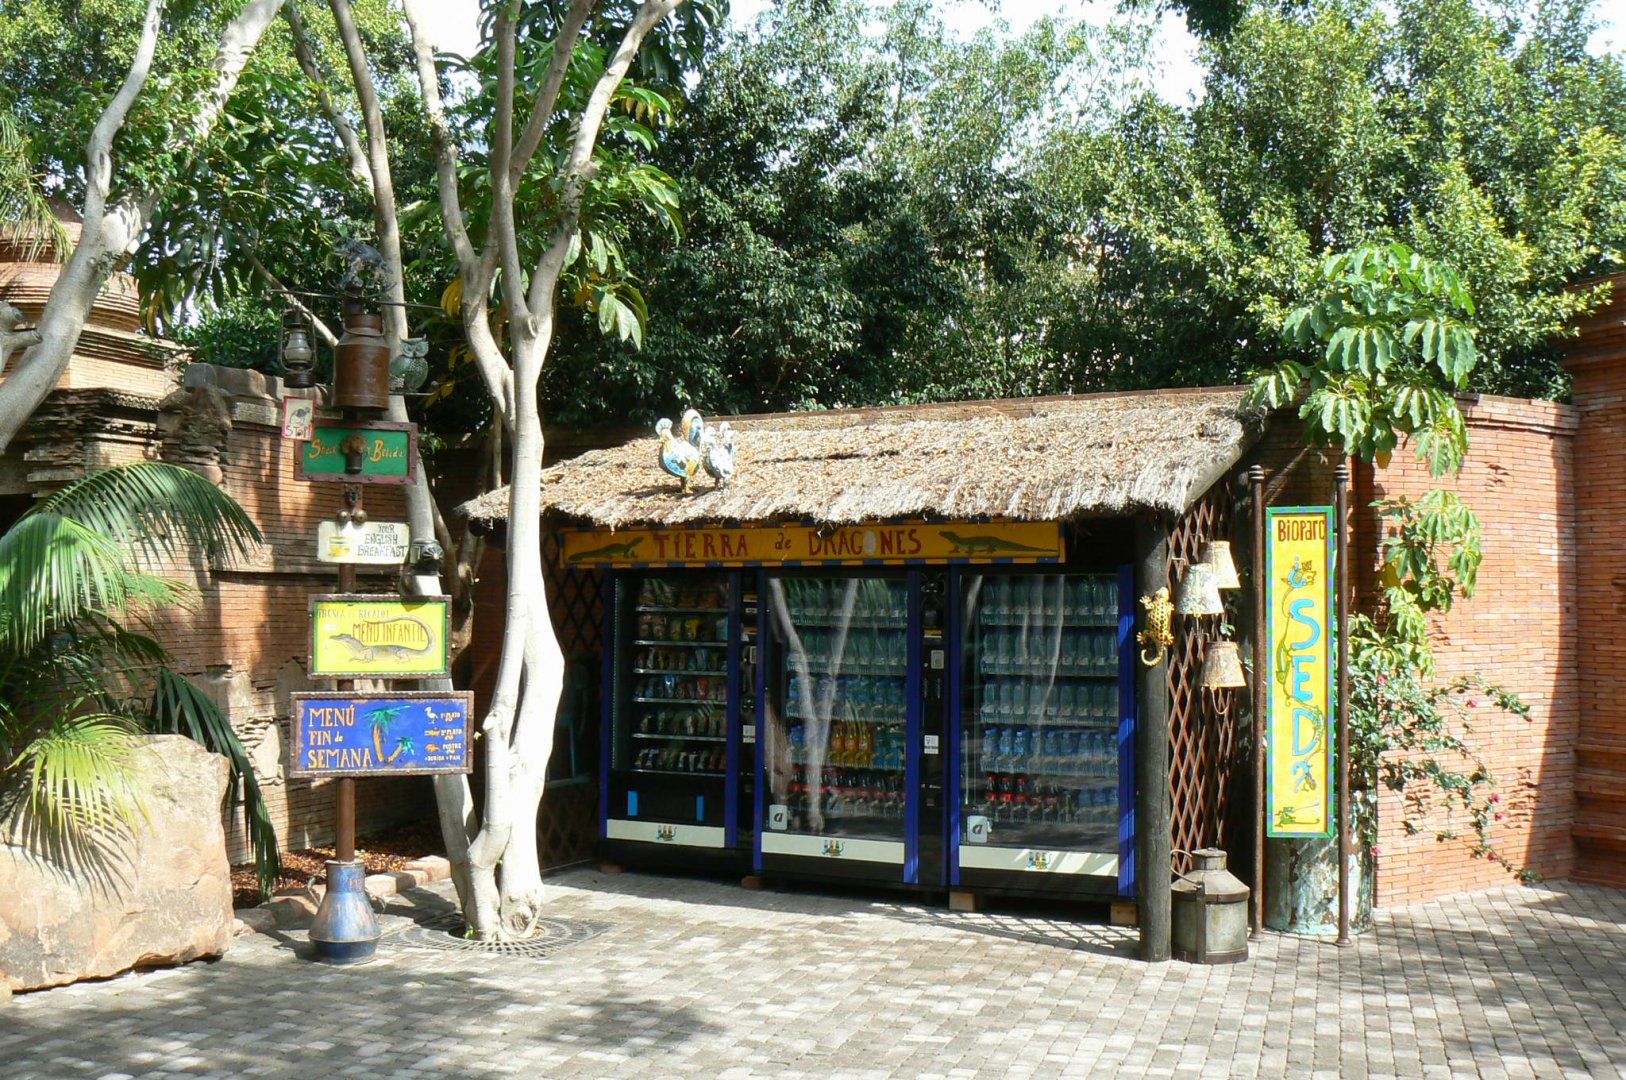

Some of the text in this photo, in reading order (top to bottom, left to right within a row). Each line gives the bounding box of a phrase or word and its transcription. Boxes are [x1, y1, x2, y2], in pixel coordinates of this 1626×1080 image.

[364, 532, 398, 546] ENGLISH
[652, 528, 923, 560] TIERRA de DRAGONES
[382, 622, 427, 643] INFANTIL
[308, 704, 355, 728] MENÚ
[308, 730, 332, 746] FIN
[307, 747, 374, 769] SEMANA
